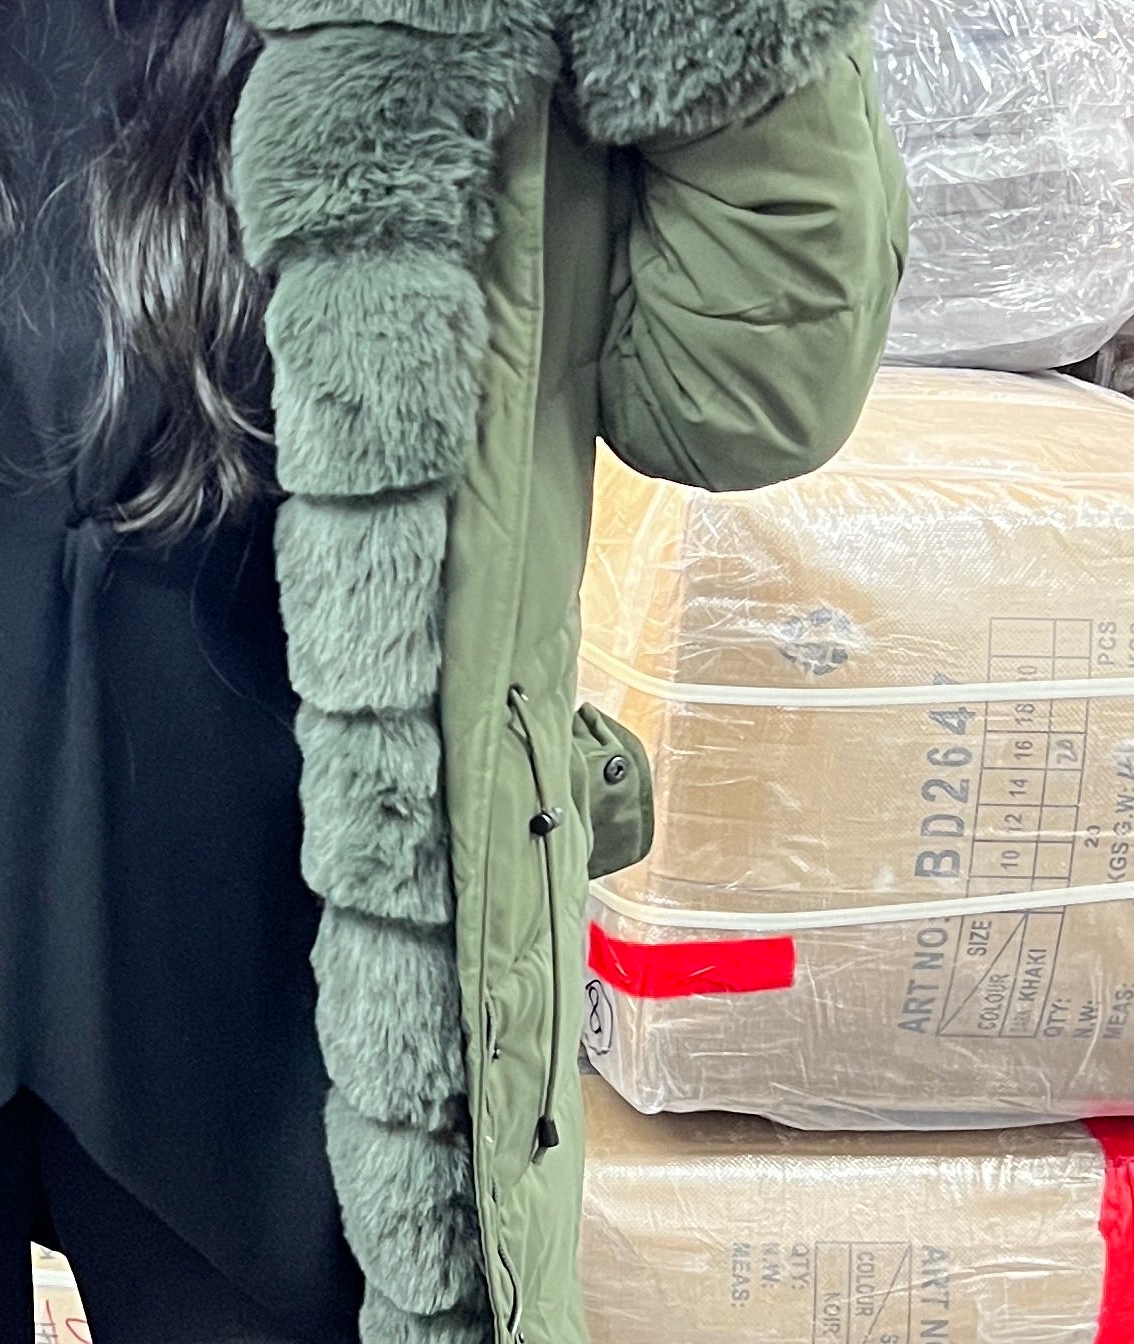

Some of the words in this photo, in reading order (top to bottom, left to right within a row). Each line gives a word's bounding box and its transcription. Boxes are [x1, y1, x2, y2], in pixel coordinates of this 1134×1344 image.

[1017, 665, 1038, 681] 0
[1015, 703, 1036, 725] 18
[1014, 740, 1033, 760] 16
[1009, 778, 1028, 797] 14
[1004, 813, 1022, 832] 12
[1043, 998, 1071, 1037] QTY:
[1084, 825, 1101, 849] 20
[1097, 621, 1117, 666] PCS
[1000, 850, 1021, 870] 10
[967, 920, 992, 957] SIZE
[1018, 949, 1047, 1002] KHAKI
[898, 978, 939, 1034] ART
[977, 974, 1010, 1030] COLOUR
[1072, 1000, 1100, 1038] N.W:
[1103, 983, 1134, 1038] MEAS:
[730, 1242, 752, 1308] MEAS:
[762, 1241, 781, 1289] N.W:
[791, 1242, 810, 1290] QTY:
[855, 1250, 875, 1317] COLOUR
[921, 1244, 950, 1310] ART
[822, 1291, 842, 1336] NOIR
